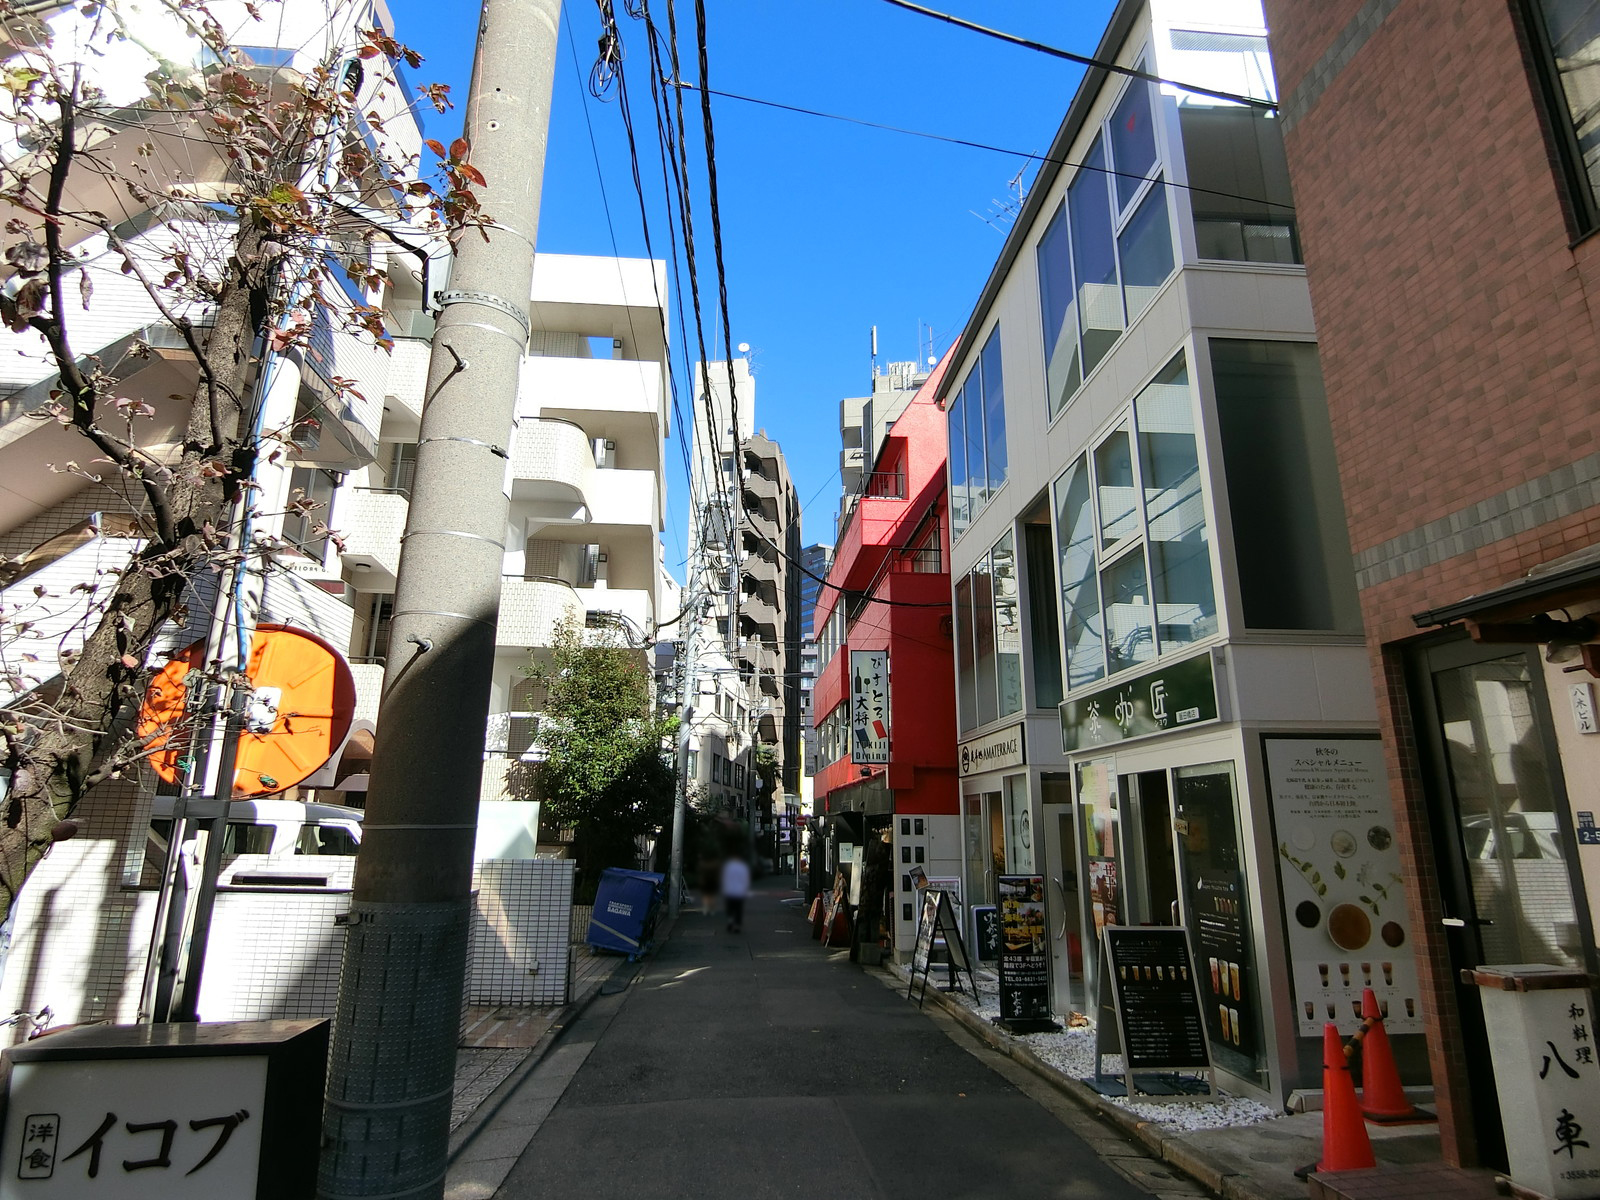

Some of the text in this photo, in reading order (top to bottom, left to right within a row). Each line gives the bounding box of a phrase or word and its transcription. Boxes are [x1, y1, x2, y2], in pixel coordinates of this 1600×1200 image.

[870, 657, 884, 720] びすとろ
[1573, 687, 1591, 730] 八木ビル
[854, 696, 870, 727] 大将
[855, 752, 887, 761] Dining
[983, 738, 1018, 761] AMATERRACE
[1294, 758, 1363, 767] スペシャルメニュー
[1567, 1002, 1594, 1065] 和料理
[24, 1122, 54, 1170] 洋食
[61, 1108, 251, 1179] イコブ
